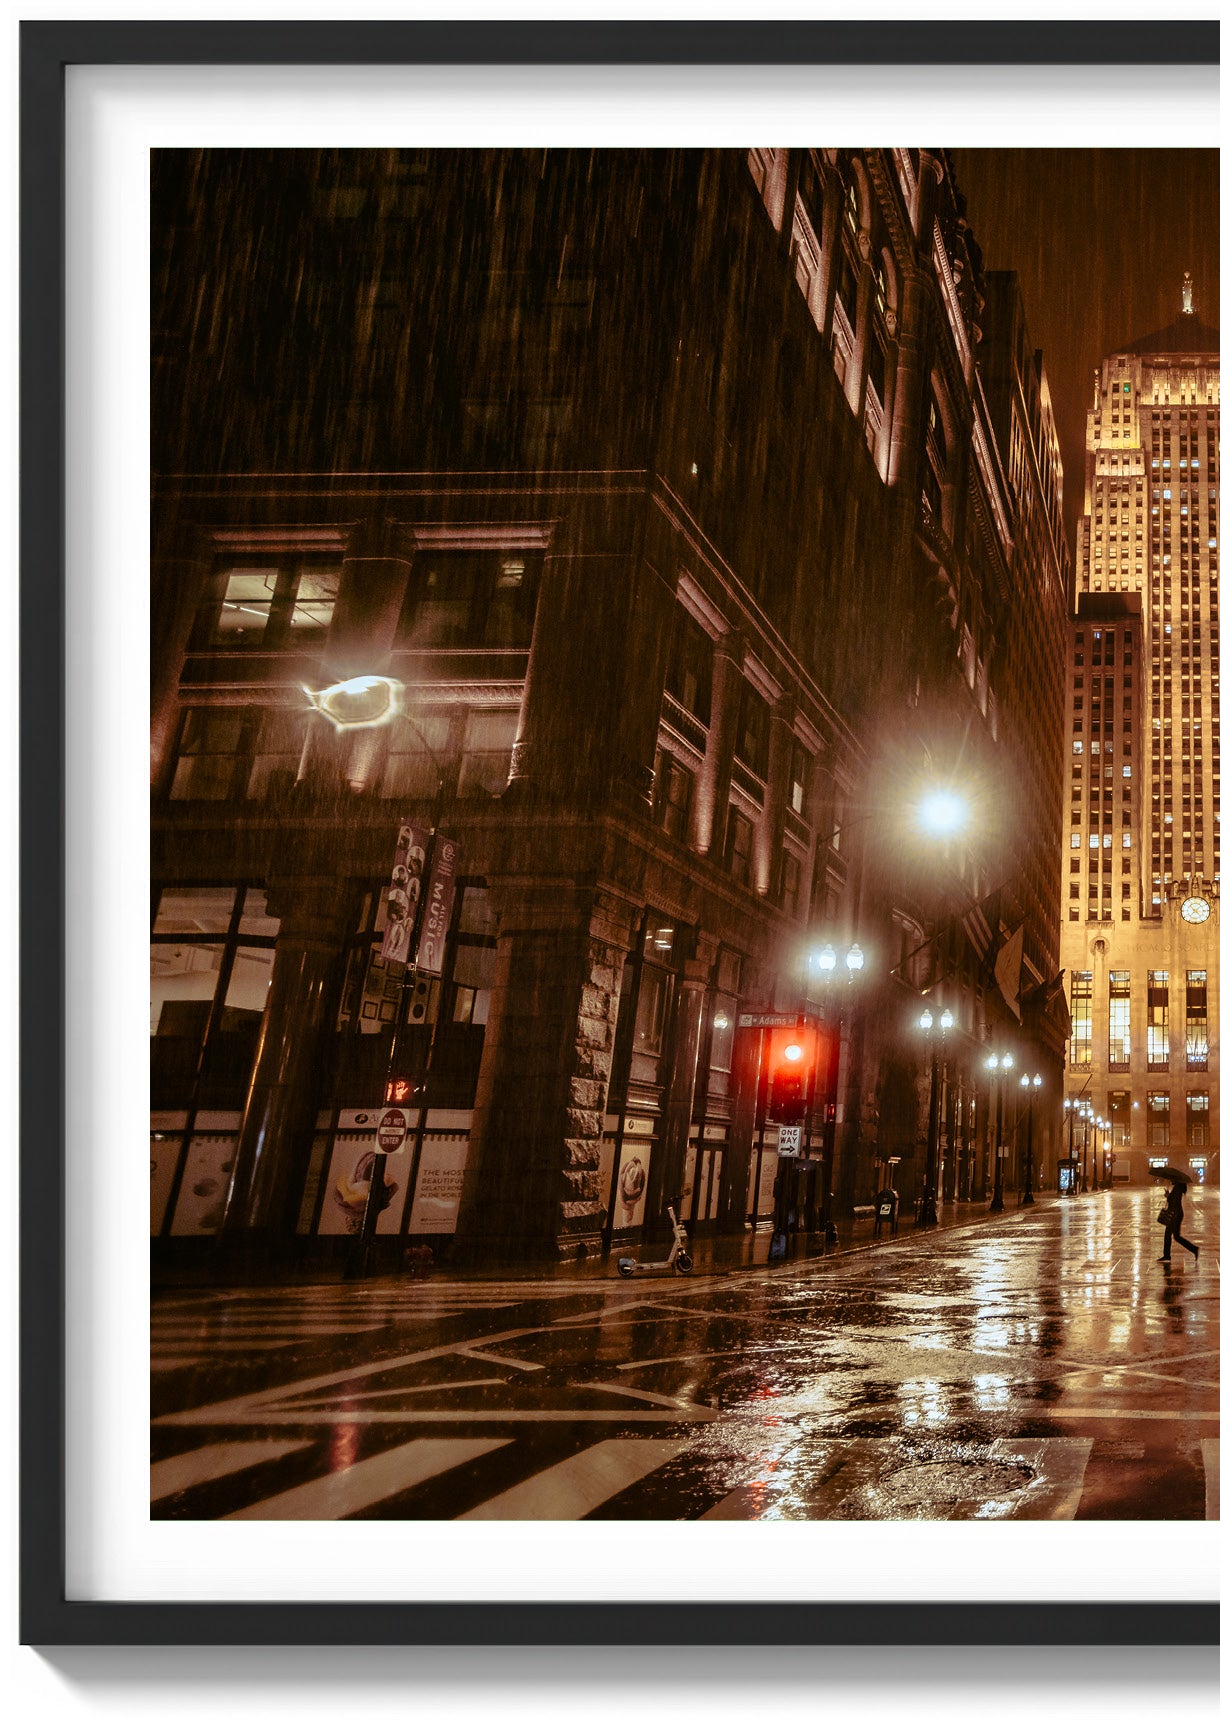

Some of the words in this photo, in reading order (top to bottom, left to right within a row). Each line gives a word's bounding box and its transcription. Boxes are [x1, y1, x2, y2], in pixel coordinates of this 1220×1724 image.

[424, 882, 444, 955] MUSIC
[759, 1016, 787, 1025] Adams
[383, 1117, 392, 1125] DO
[393, 1117, 405, 1126] NOT
[382, 1136, 400, 1145] ENTER
